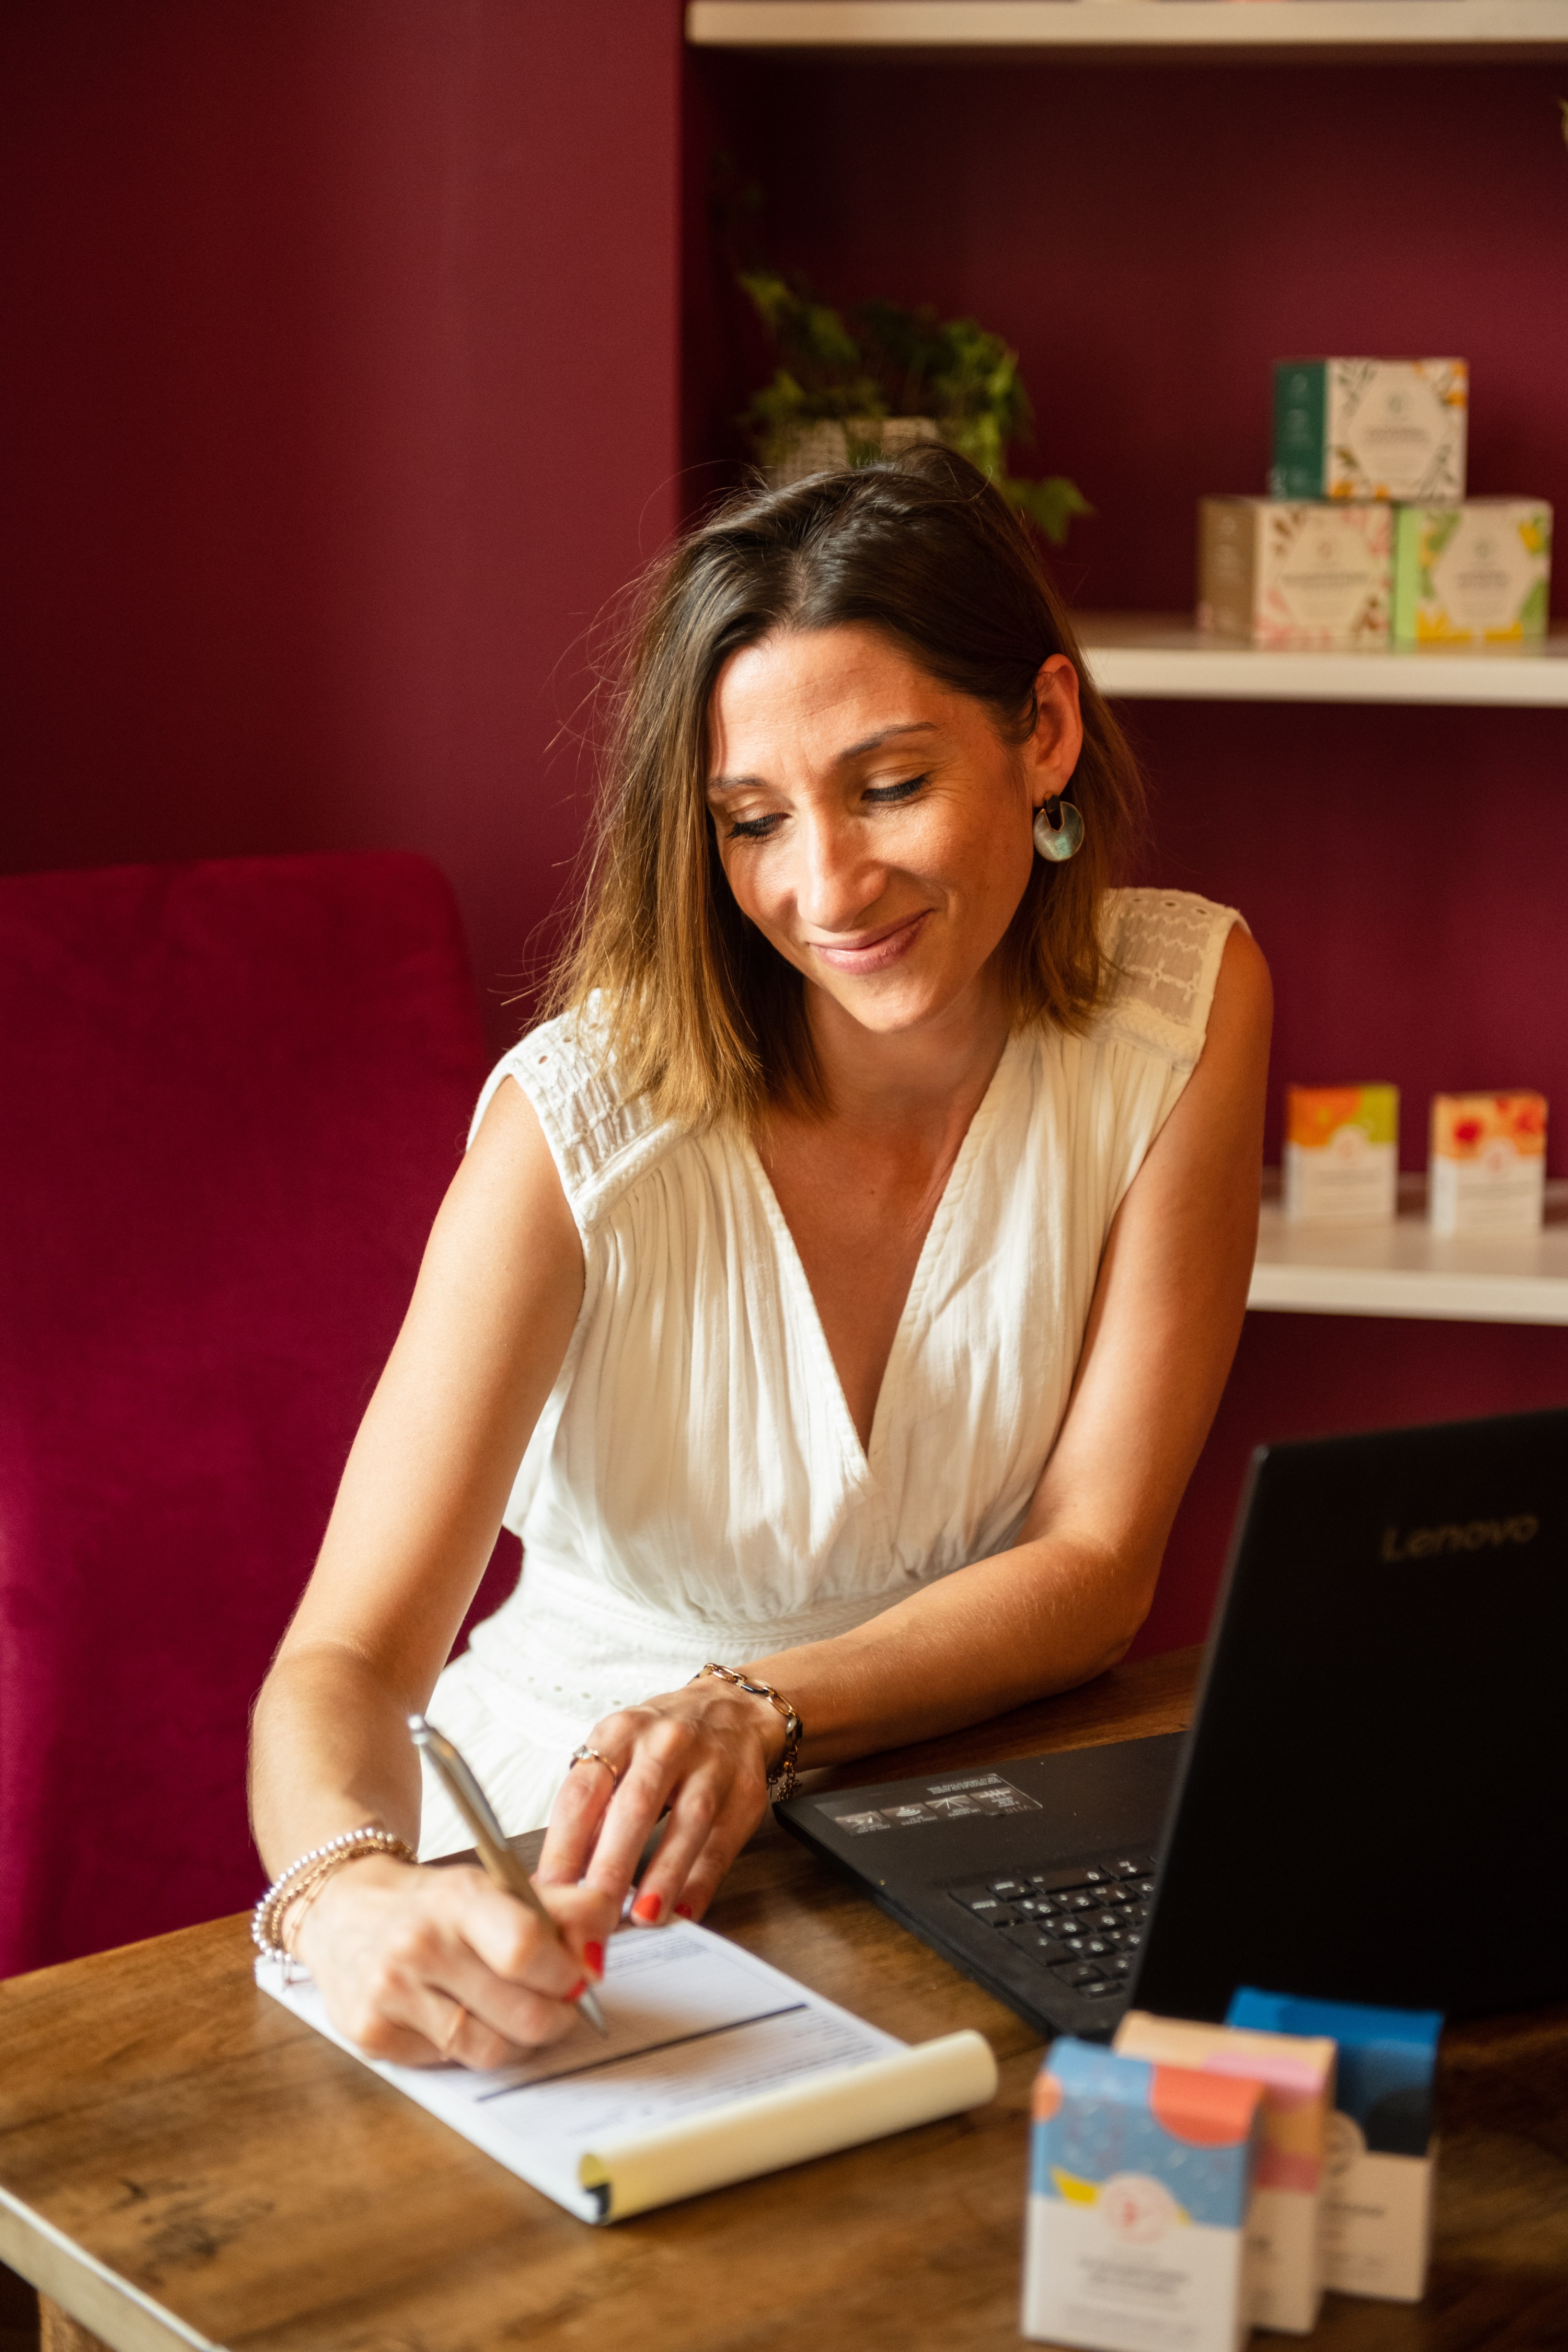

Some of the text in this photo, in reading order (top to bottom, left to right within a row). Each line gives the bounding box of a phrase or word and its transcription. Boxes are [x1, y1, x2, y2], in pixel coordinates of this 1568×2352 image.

[1380, 1513, 1539, 1561] Lenovo
[1088, 1871, 1099, 1880] 0
[971, 1900, 996, 1910] Enter
[1076, 1897, 1088, 1906] 2
[1038, 1904, 1051, 1913] 3
[1102, 1916, 1115, 1926] 5
[1063, 1922, 1077, 1932] 6
